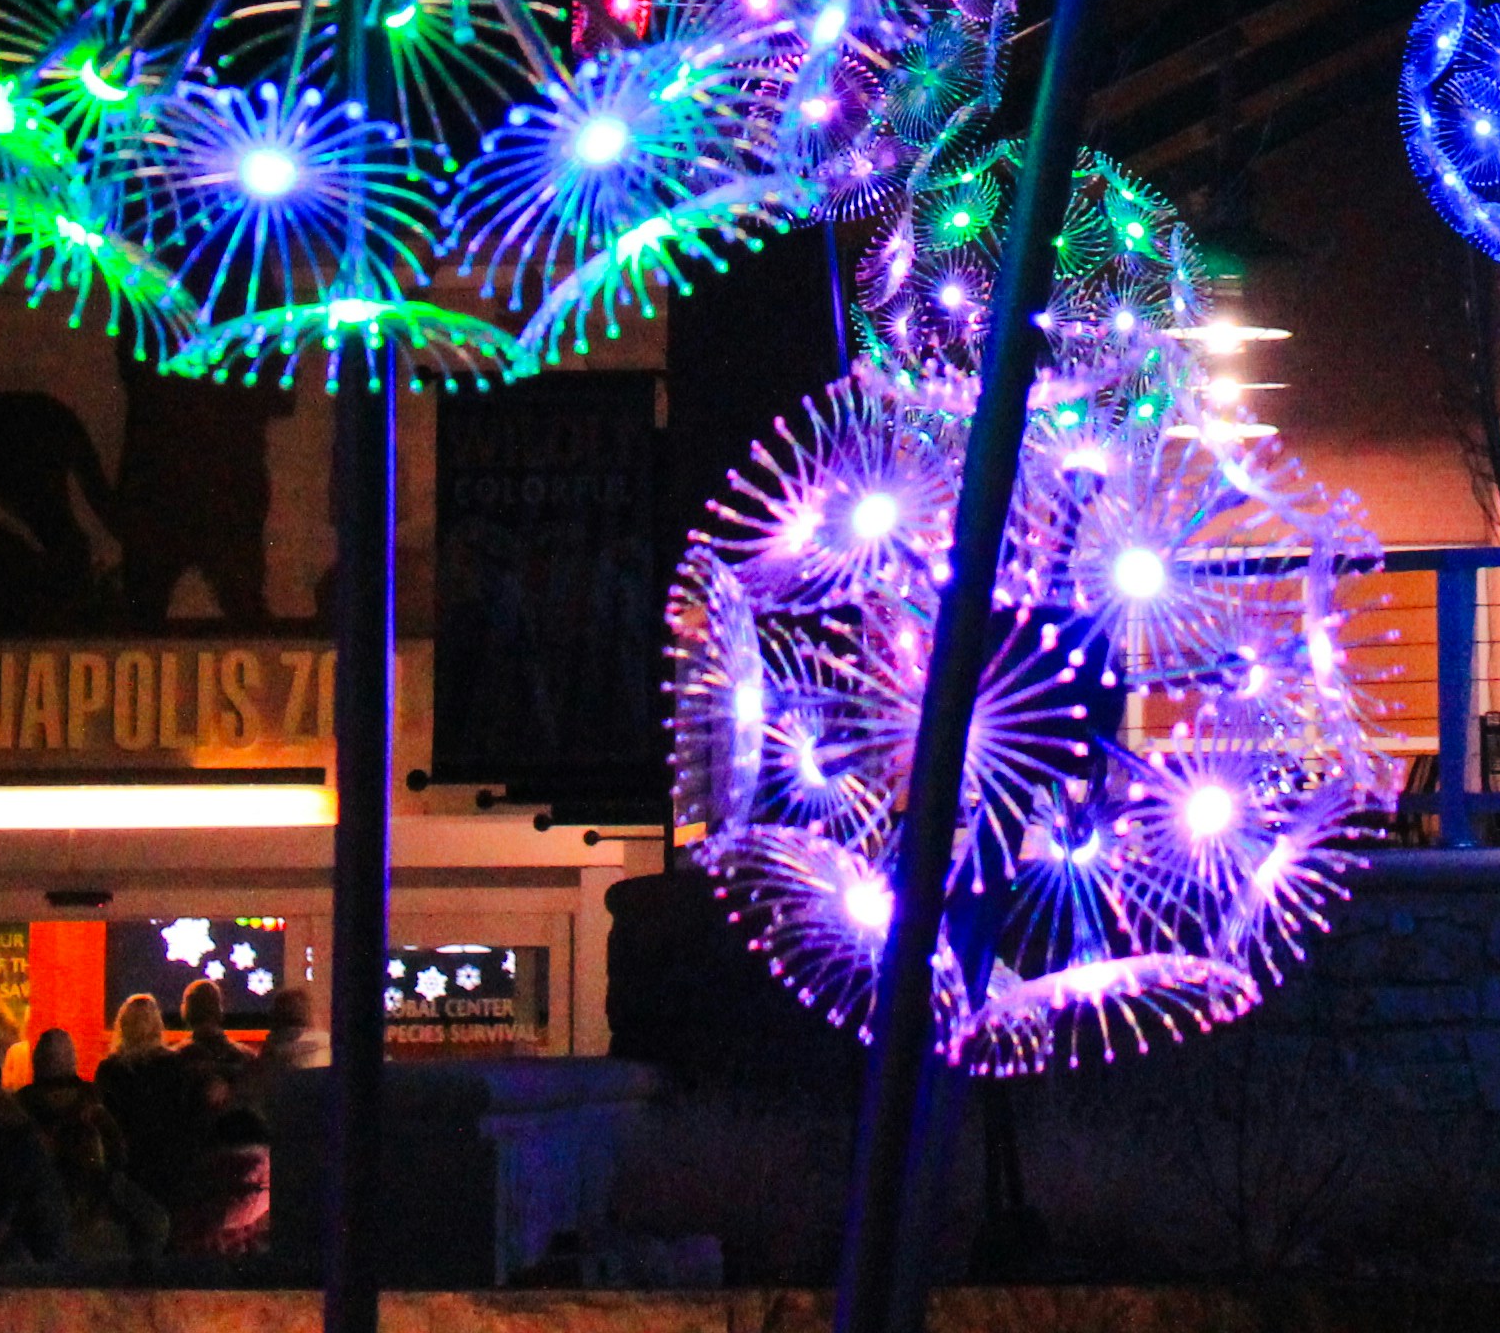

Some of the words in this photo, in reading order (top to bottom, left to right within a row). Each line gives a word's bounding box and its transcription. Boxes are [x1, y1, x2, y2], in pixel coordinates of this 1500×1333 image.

[453, 475, 632, 505] COLORFUL
[444, 997, 514, 1017] CENTER
[449, 1024, 538, 1043] SURVIVAL
